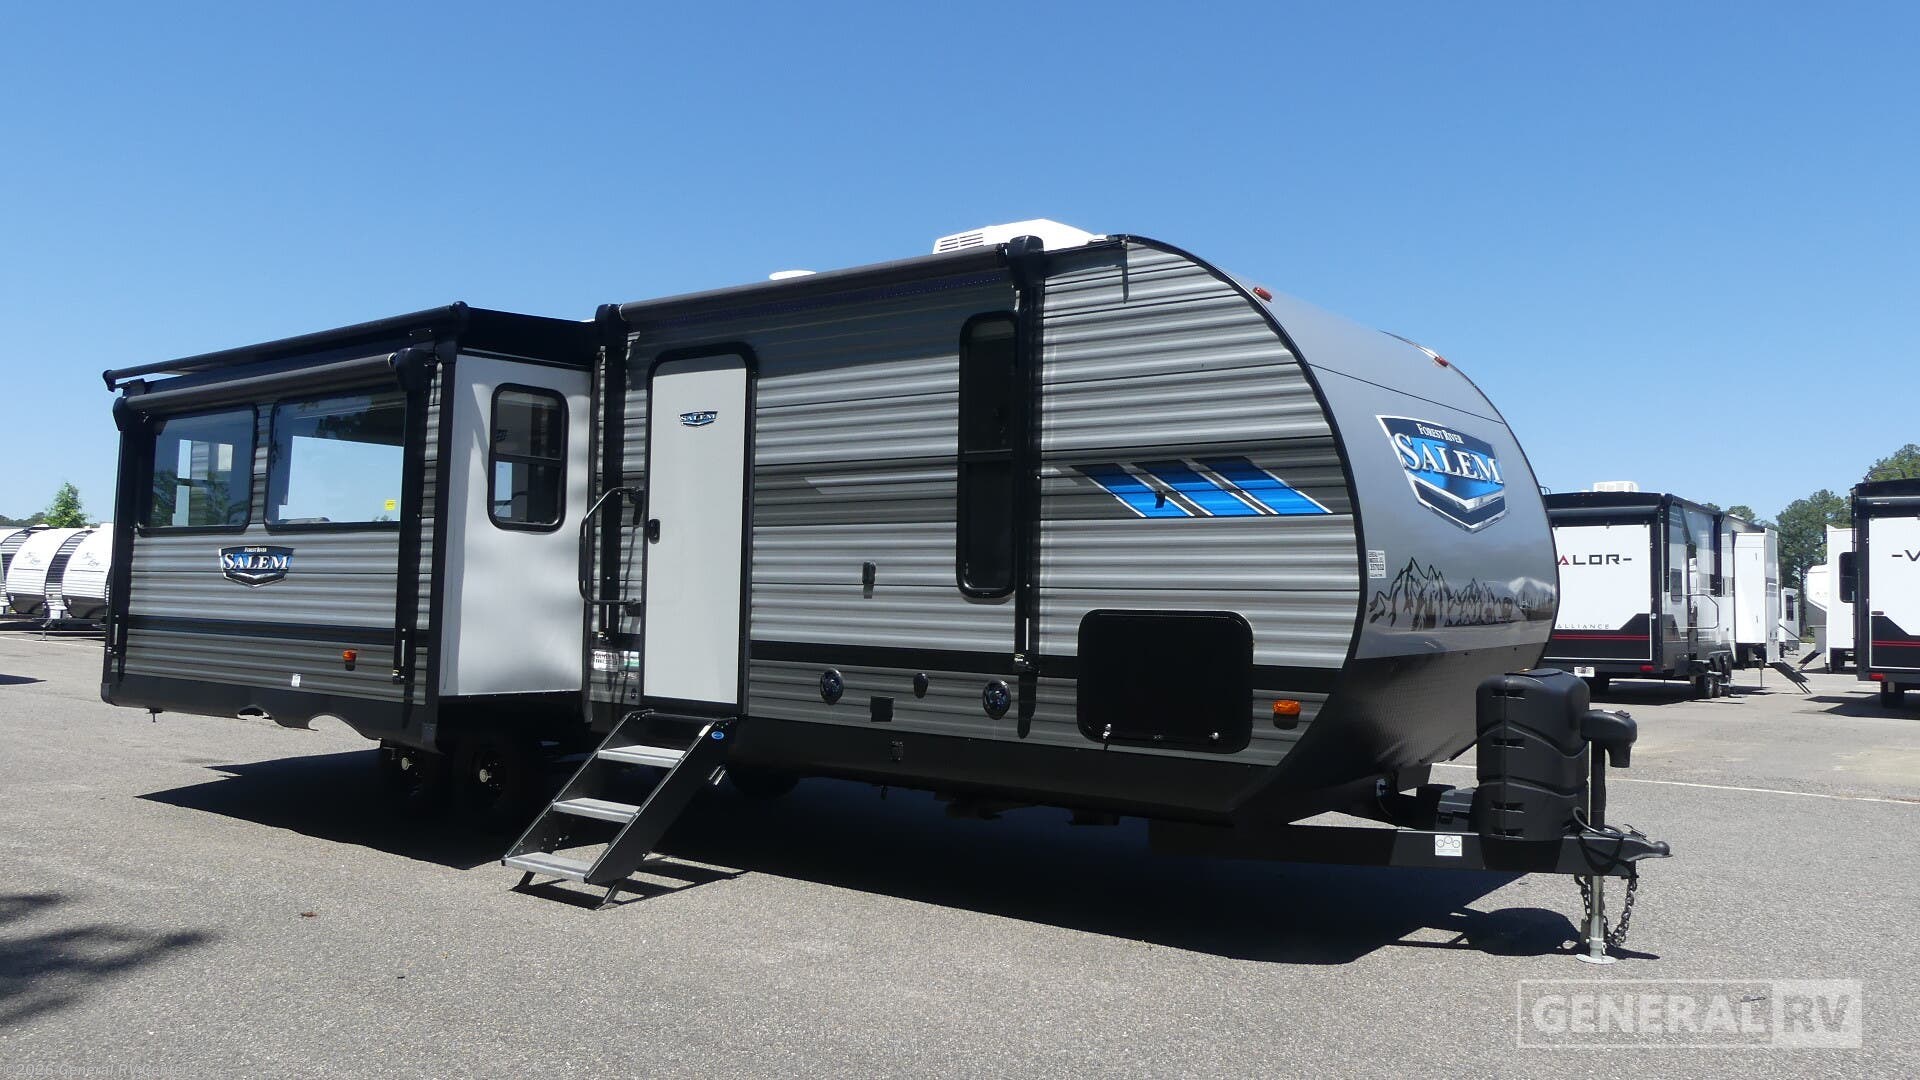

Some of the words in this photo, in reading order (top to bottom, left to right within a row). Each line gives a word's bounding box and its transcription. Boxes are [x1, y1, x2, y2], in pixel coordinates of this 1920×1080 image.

[1416, 423, 1444, 439] FOREST
[1441, 429, 1464, 444] RIVER
[1394, 433, 1503, 484] SALEM
[224, 553, 288, 570] SALEM
